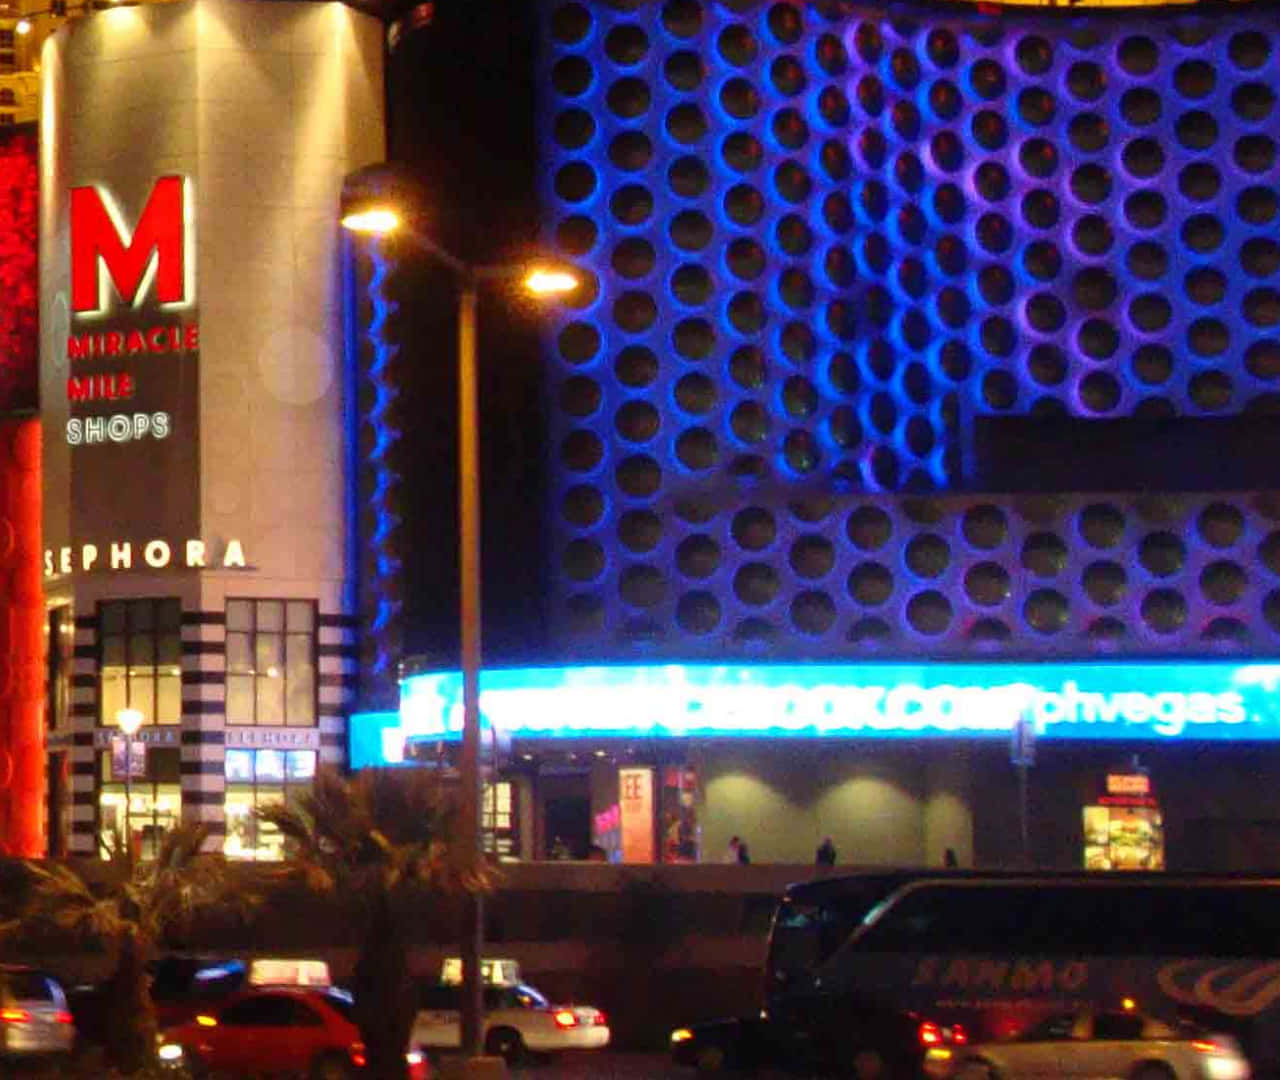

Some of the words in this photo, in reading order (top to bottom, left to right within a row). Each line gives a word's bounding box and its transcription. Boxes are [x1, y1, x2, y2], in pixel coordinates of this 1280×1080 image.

[69, 174, 196, 318] M
[66, 323, 201, 360] MIRACLE
[66, 372, 134, 402] MILE
[66, 411, 170, 446] SHOPS
[43, 539, 247, 577] SEPHORA
